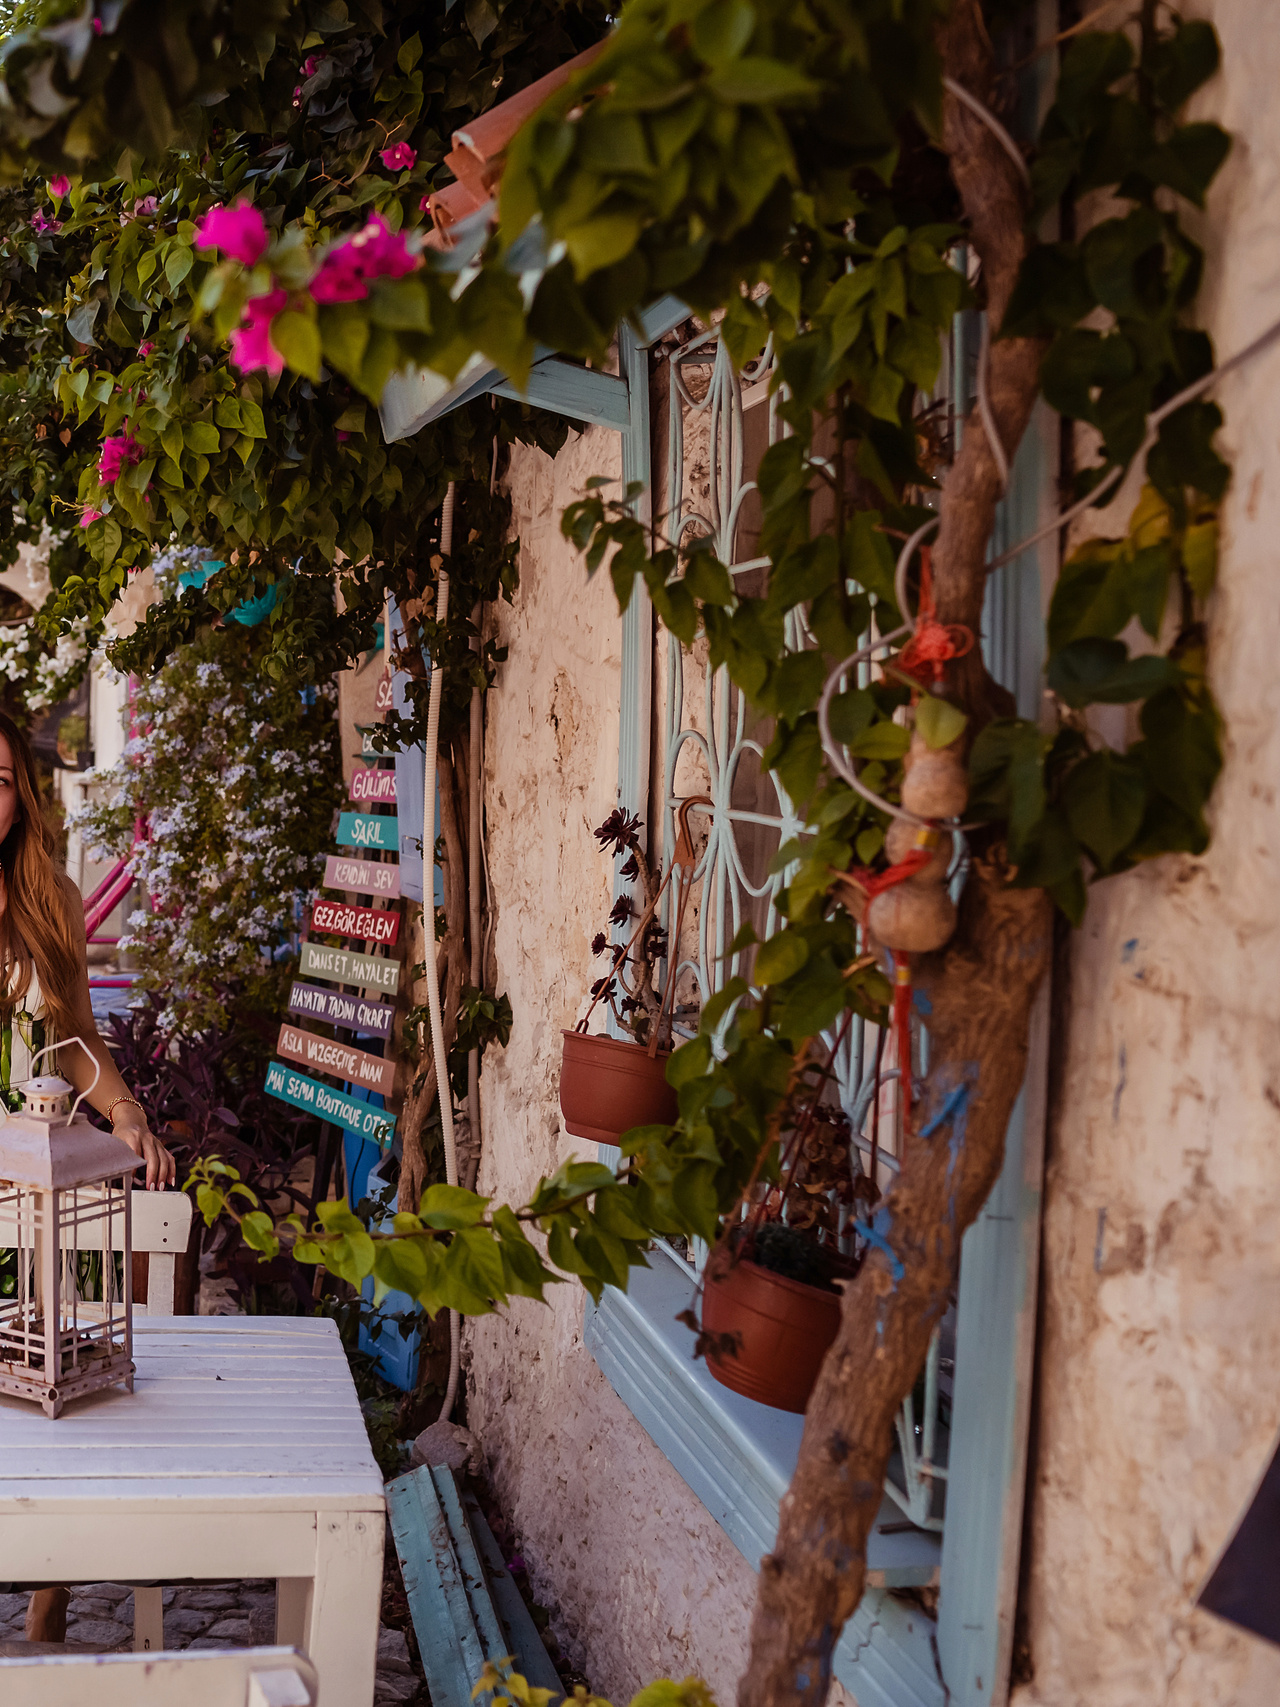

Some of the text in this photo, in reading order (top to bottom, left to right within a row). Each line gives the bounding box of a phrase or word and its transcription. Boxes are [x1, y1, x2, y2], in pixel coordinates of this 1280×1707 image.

[353, 771, 399, 799] GÜLÜMS
[351, 819, 384, 846] SARIL
[373, 869, 395, 890] SEV
[290, 987, 328, 1013] HAYATIN
[281, 1030, 303, 1054] ASLA
[286, 1076, 315, 1103] SEMA
[315, 1087, 362, 1128] BOUTIQUE
